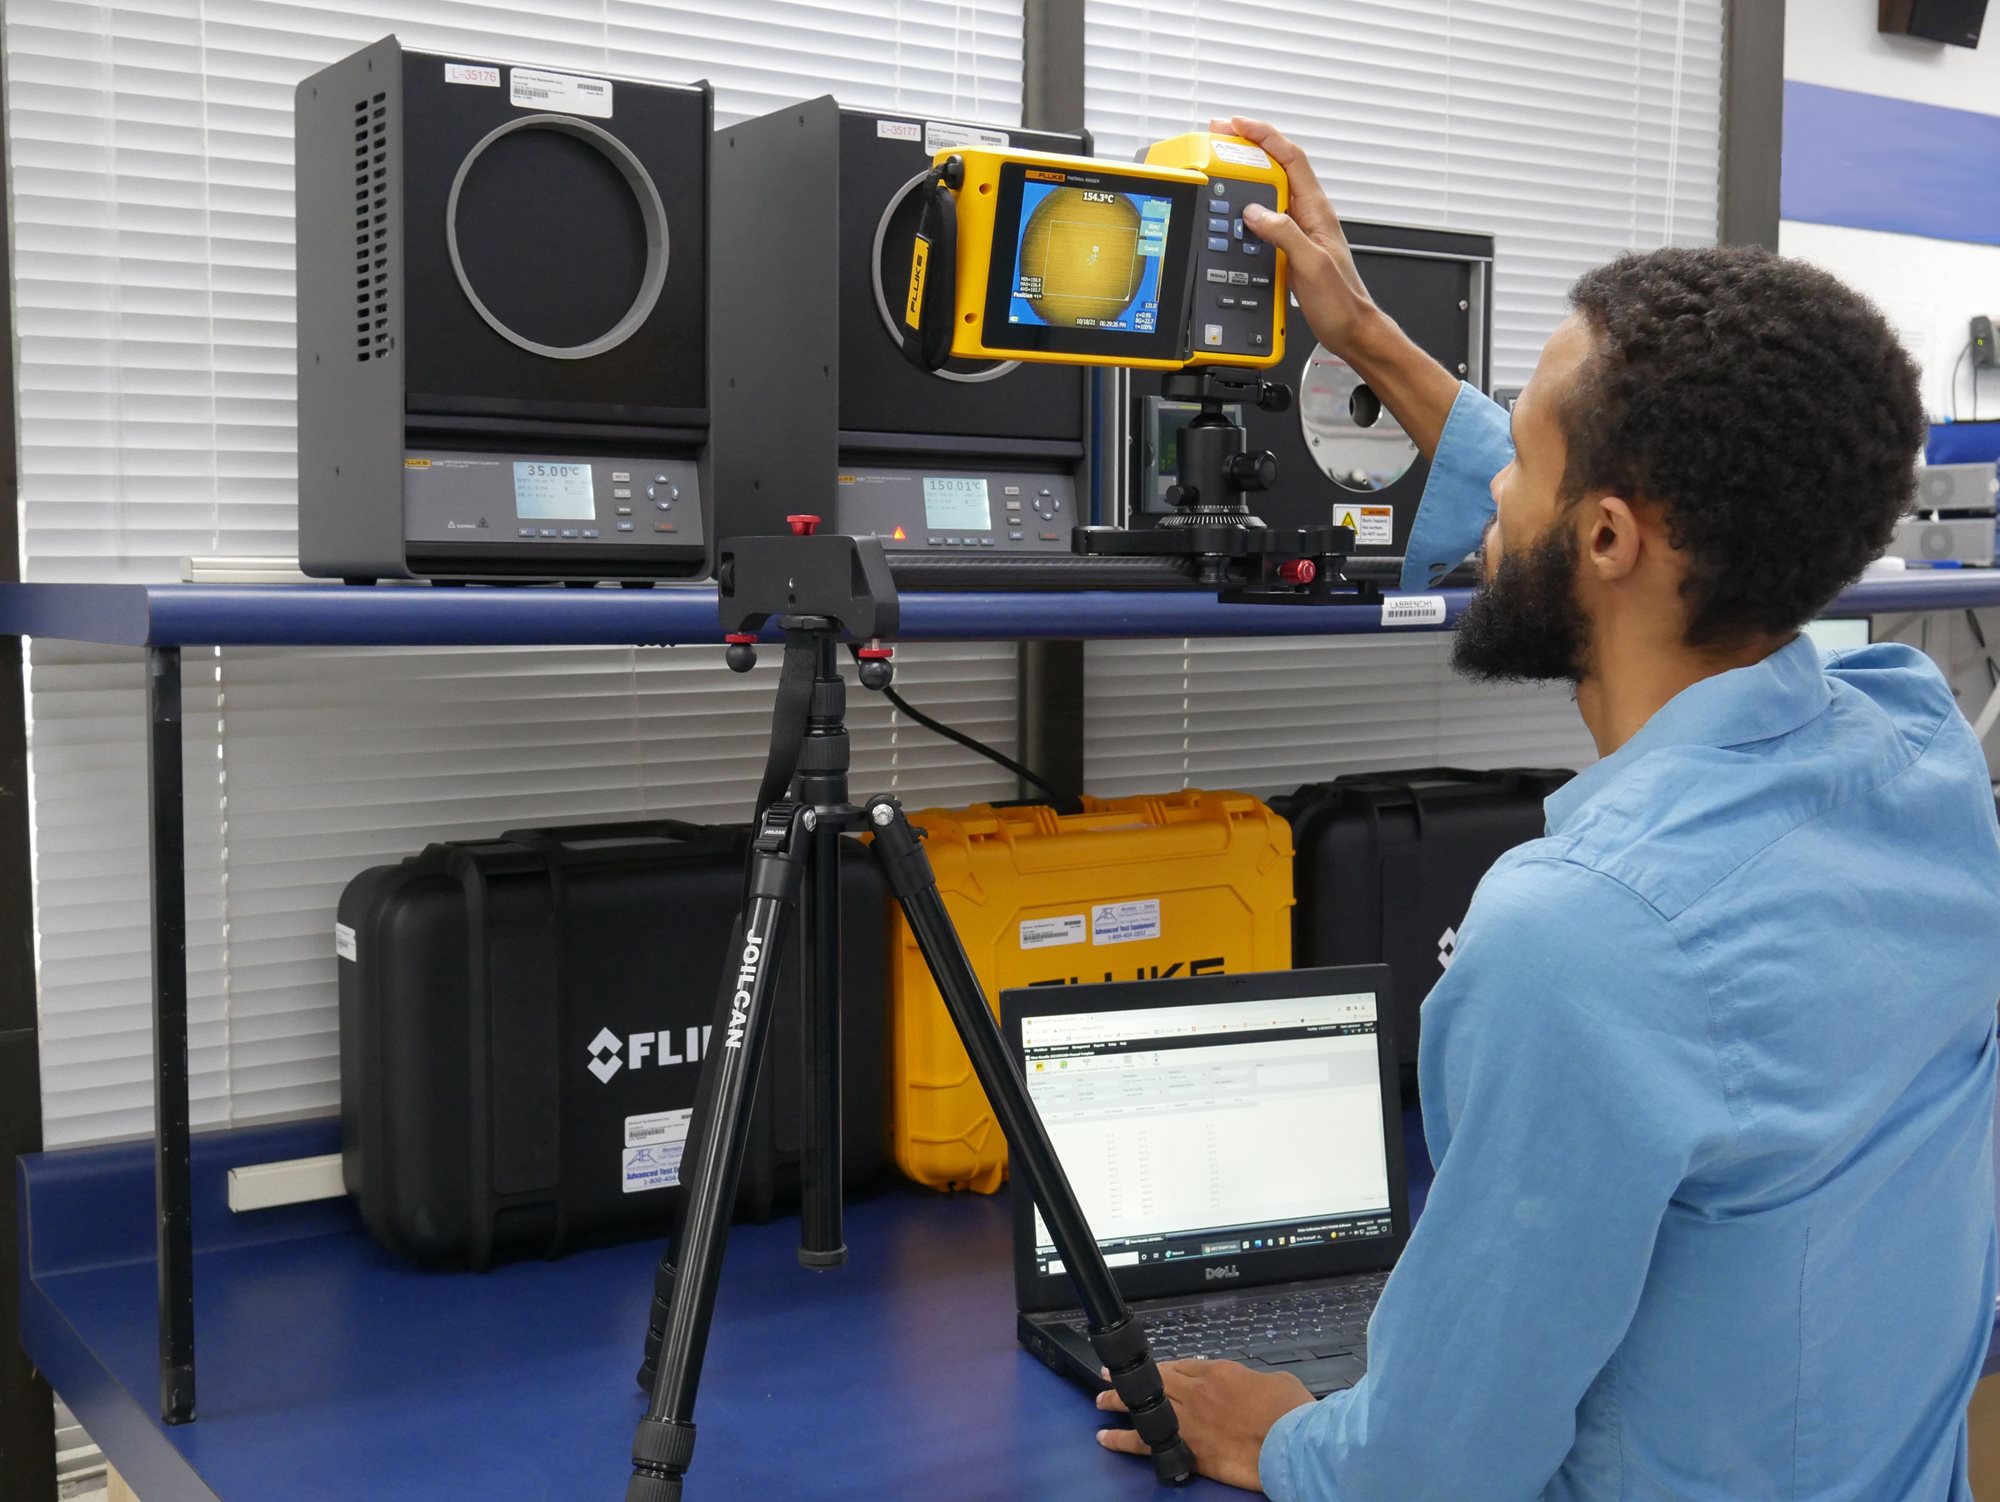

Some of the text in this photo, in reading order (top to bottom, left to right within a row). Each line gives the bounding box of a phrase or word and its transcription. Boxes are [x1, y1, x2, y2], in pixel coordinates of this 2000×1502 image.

[452, 68, 497, 82] L-35176
[881, 125, 917, 136] L-35177
[1083, 192, 1114, 203] 154.3°C
[910, 254, 923, 313] FLUKE
[1390, 601, 1433, 609] LABBENCH1
[725, 928, 763, 1048] JOILCAN
[627, 1170, 658, 1180] Advanced
[1205, 1265, 1239, 1280] DELL
